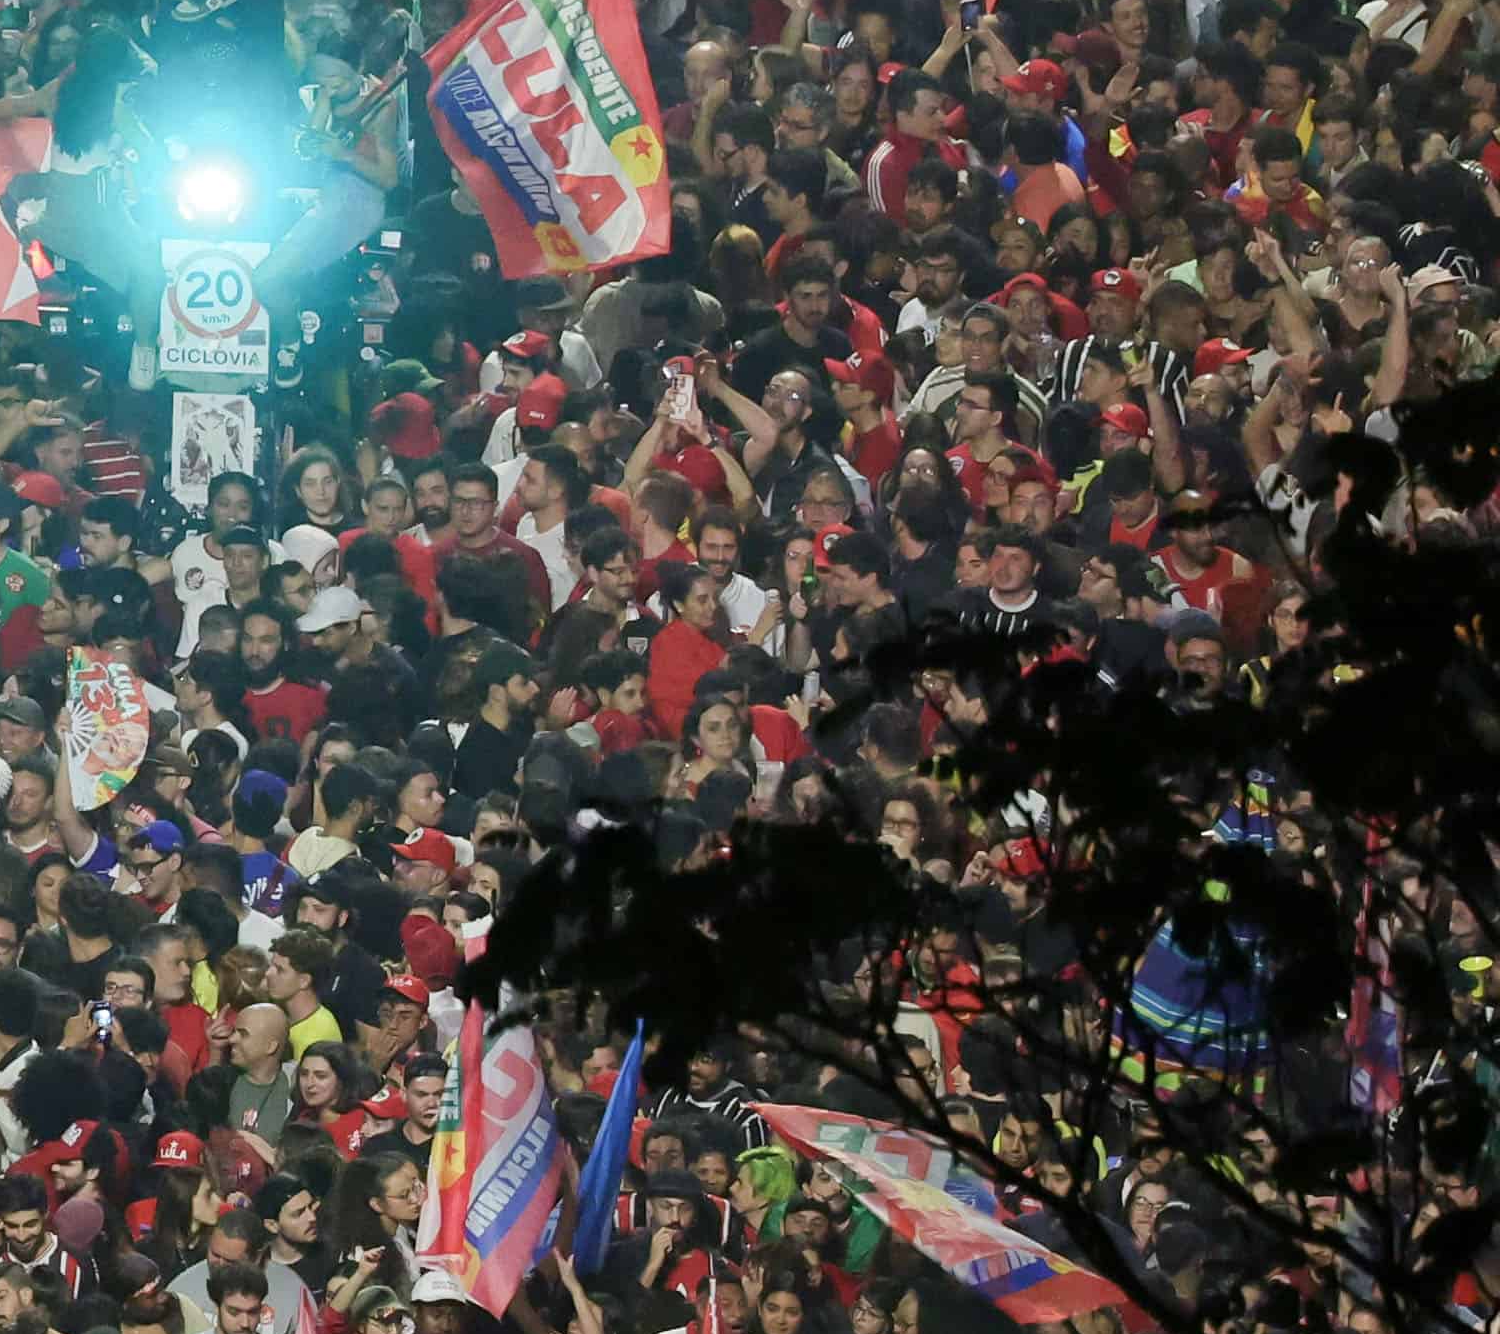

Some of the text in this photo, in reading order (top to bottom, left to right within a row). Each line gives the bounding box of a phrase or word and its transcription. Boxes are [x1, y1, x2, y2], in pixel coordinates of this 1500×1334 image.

[445, 68, 490, 113] VICE
[480, 0, 627, 235] LULA
[185, 269, 244, 309] 20
[202, 314, 231, 325] km/h
[166, 347, 261, 366] CICLOVIA
[77, 669, 119, 724] 13
[109, 662, 141, 720] LULA
[160, 1148, 190, 1161] LULA
